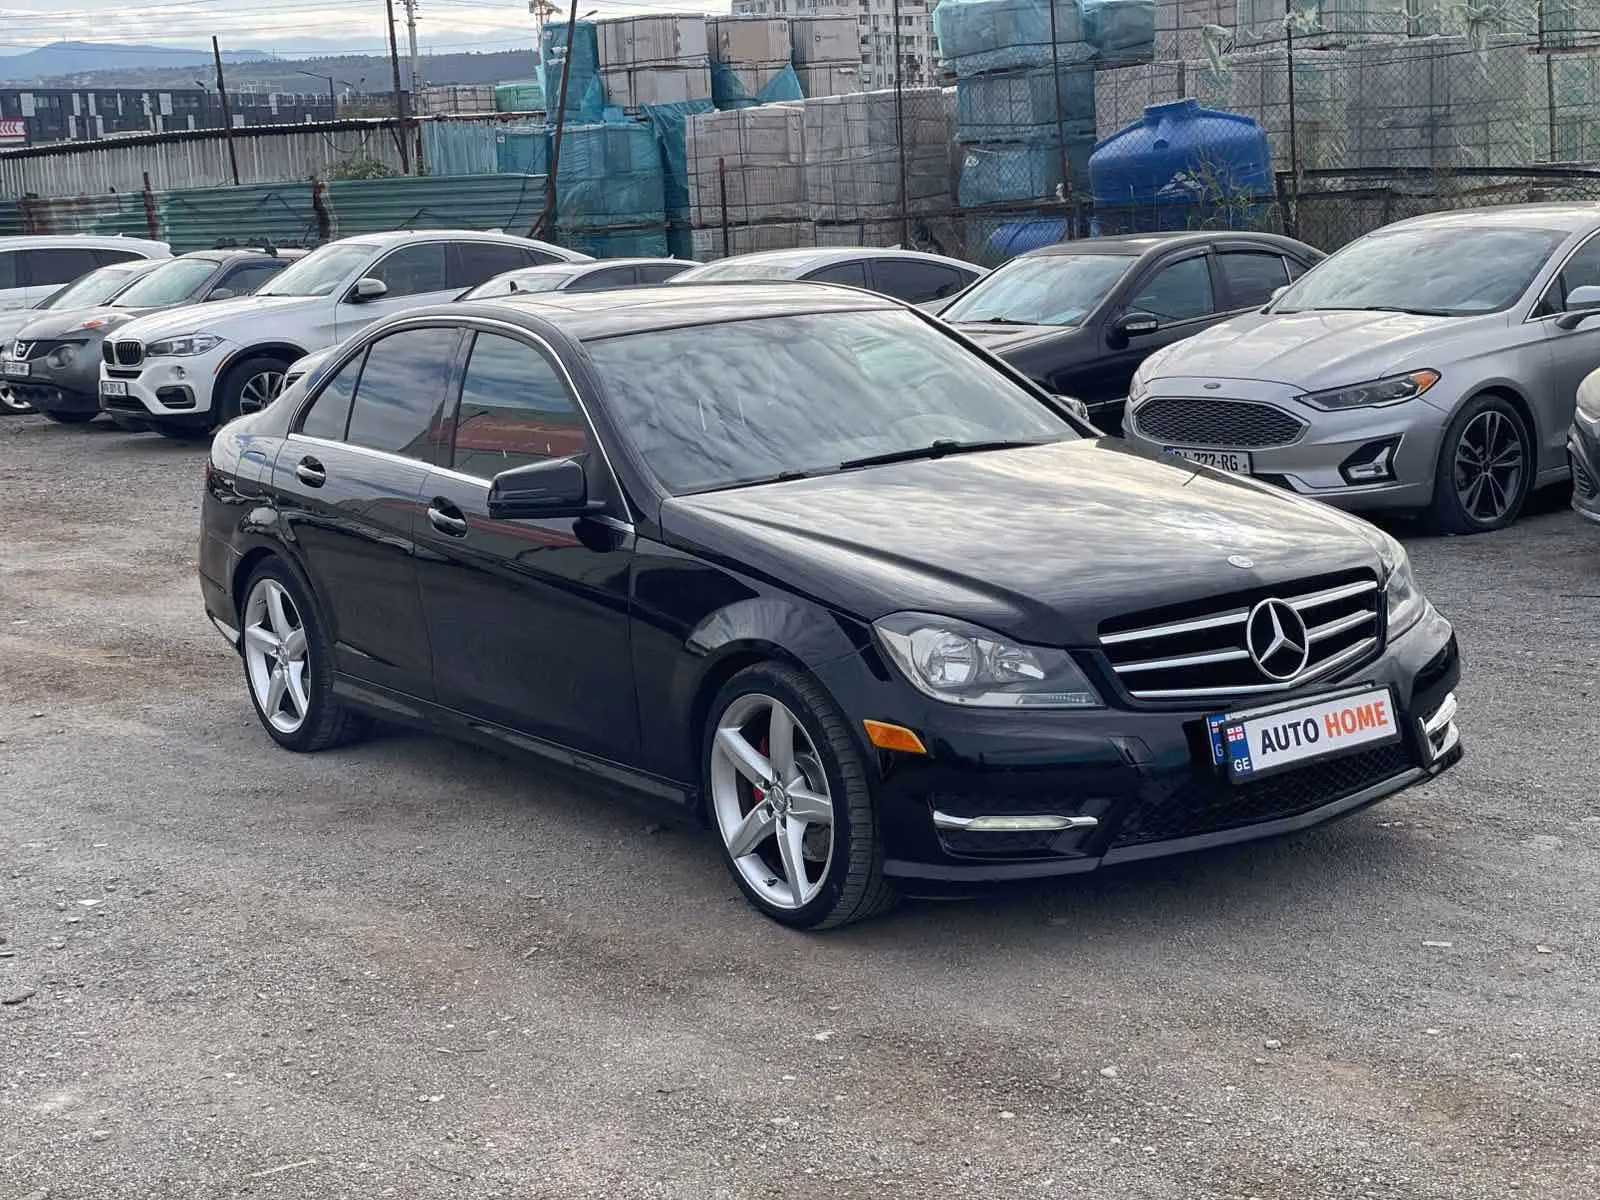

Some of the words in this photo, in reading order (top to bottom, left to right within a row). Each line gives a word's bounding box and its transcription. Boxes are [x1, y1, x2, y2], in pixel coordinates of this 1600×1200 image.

[1260, 718, 1320, 755] AUTO
[1323, 700, 1389, 738] HOME
[1234, 757, 1250, 771] GE
